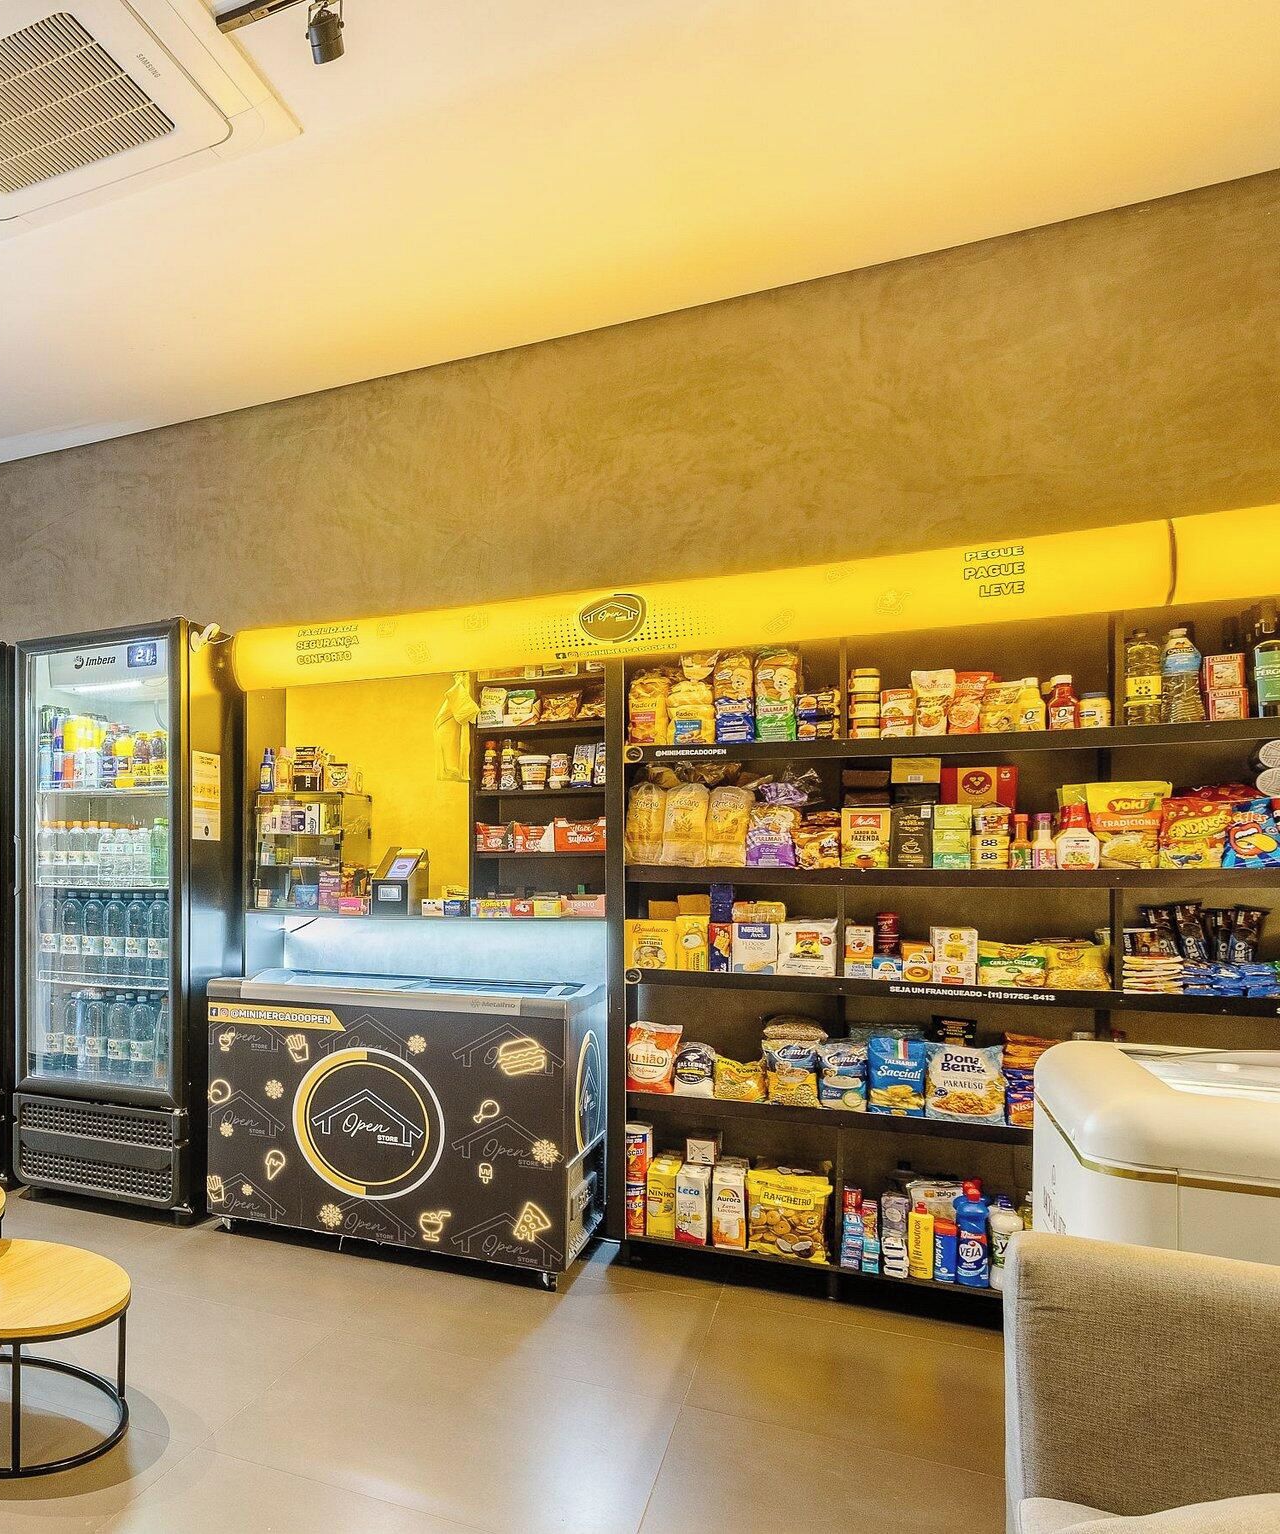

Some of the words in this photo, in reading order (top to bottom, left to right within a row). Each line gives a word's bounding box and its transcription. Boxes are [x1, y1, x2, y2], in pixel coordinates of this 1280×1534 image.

[136, 53, 161, 78] SAMSUNG
[964, 546, 1024, 562] PEGUE
[963, 562, 1025, 580] PAGUE
[979, 581, 1025, 598] LEVE
[297, 625, 359, 637] FACILIDADE
[296, 635, 360, 651] SEGURANÇA
[85, 656, 116, 667] Imbera
[297, 651, 352, 665] CONFORTO
[655, 748, 727, 757] @MINIMERCADOOPEN
[1112, 799, 1146, 811] Yoki
[1101, 819, 1160, 828] TRADICIONAL
[1170, 811, 1232, 838] FANDANGOS
[851, 834, 880, 842] FAZENDA
[632, 923, 669, 934] Bauducco
[889, 985, 911, 994] SEJA
[925, 988, 982, 998] FRANQUEADO
[230, 1009, 331, 1024] @MINIMERCADOOPEN
[944, 1053, 980, 1064] Dona
[941, 1063, 986, 1074] Benta
[943, 1079, 984, 1090] PARAFUSO
[342, 1112, 390, 1138] Open
[483, 1139, 531, 1161] Open
[648, 1188, 675, 1199] NINHO
[677, 1185, 700, 1196] Leco
[222, 1192, 260, 1212] Open
[716, 1195, 741, 1204] Aurora
[763, 1191, 812, 1206] RANCHEIRO
[344, 1213, 387, 1234] Open
[482, 1234, 529, 1257] Open
[960, 1246, 980, 1256] VEJA
[518, 1256, 538, 1264] STORE
